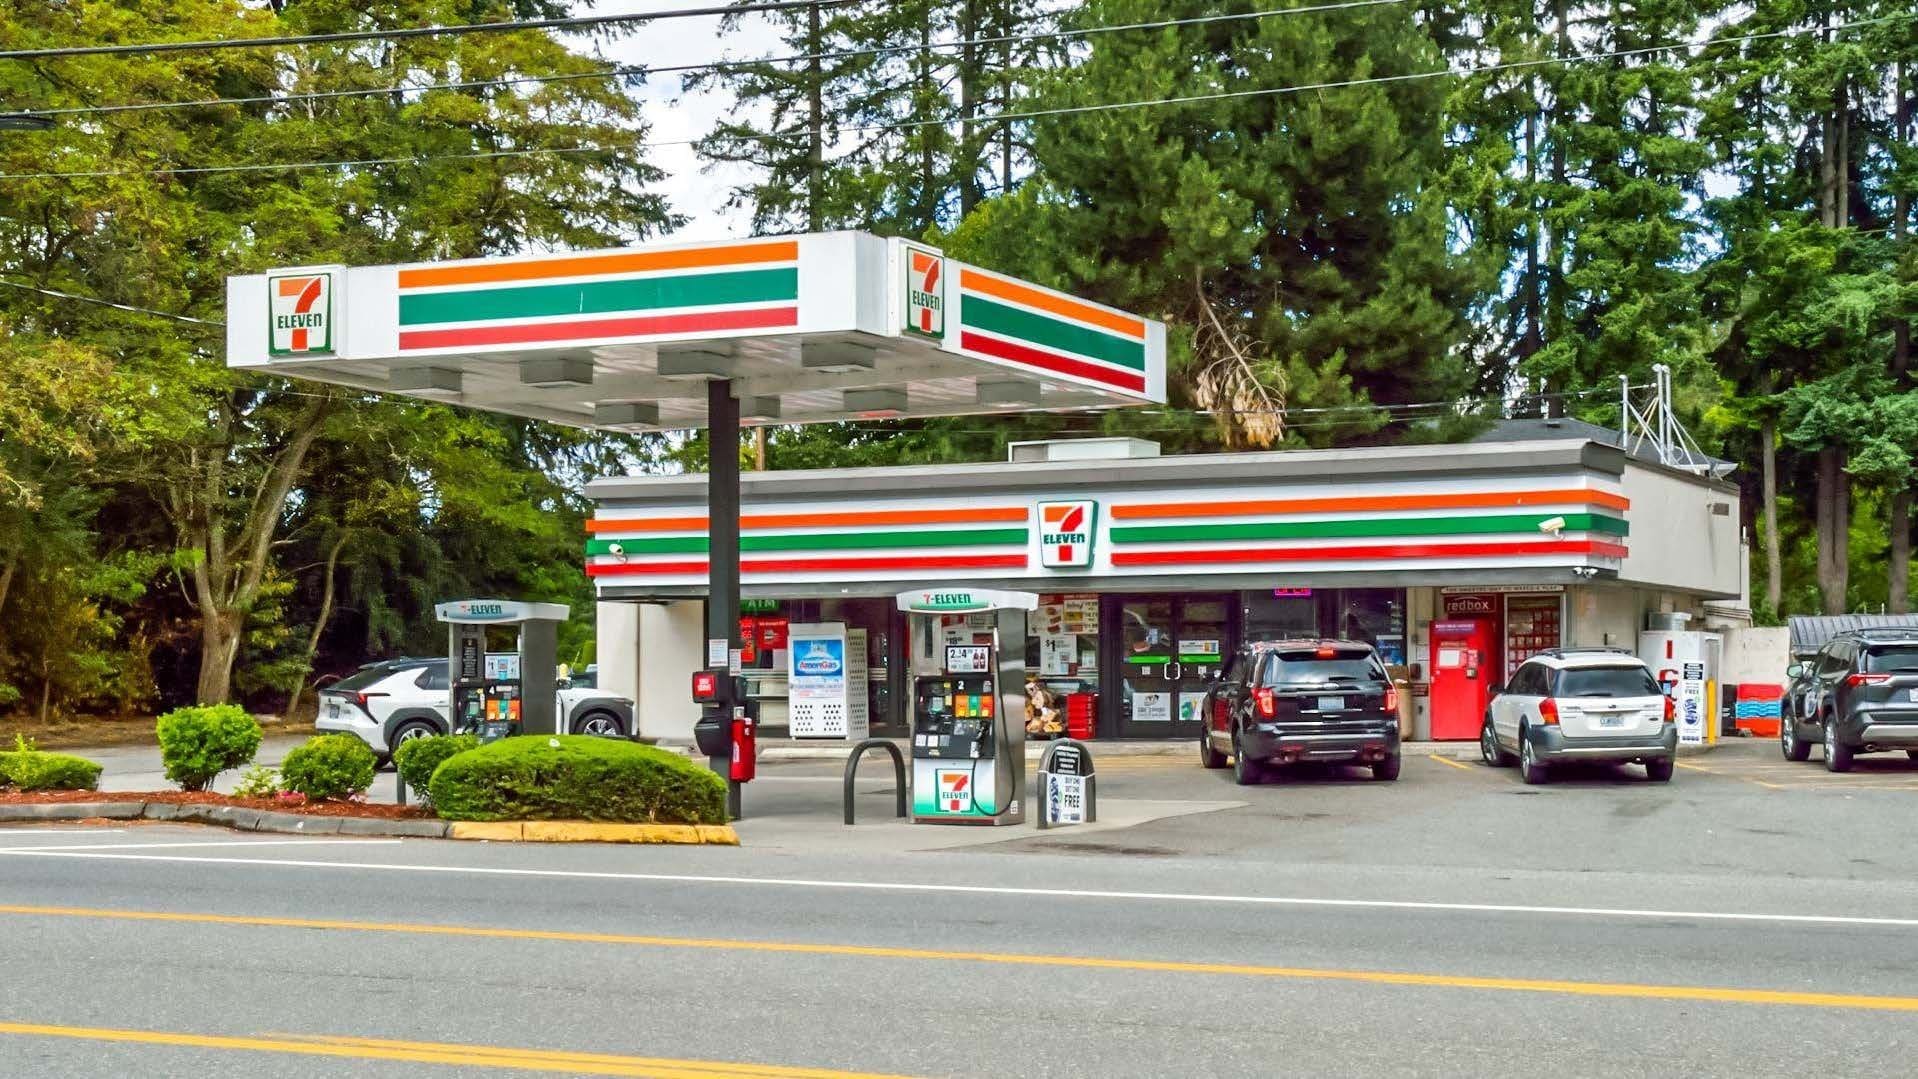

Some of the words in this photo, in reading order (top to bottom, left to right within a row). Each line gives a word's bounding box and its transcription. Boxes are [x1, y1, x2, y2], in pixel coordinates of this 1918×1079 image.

[1447, 600, 1489, 611] redbox
[958, 681, 965, 690] 2
[1064, 795, 1080, 808] FREE
